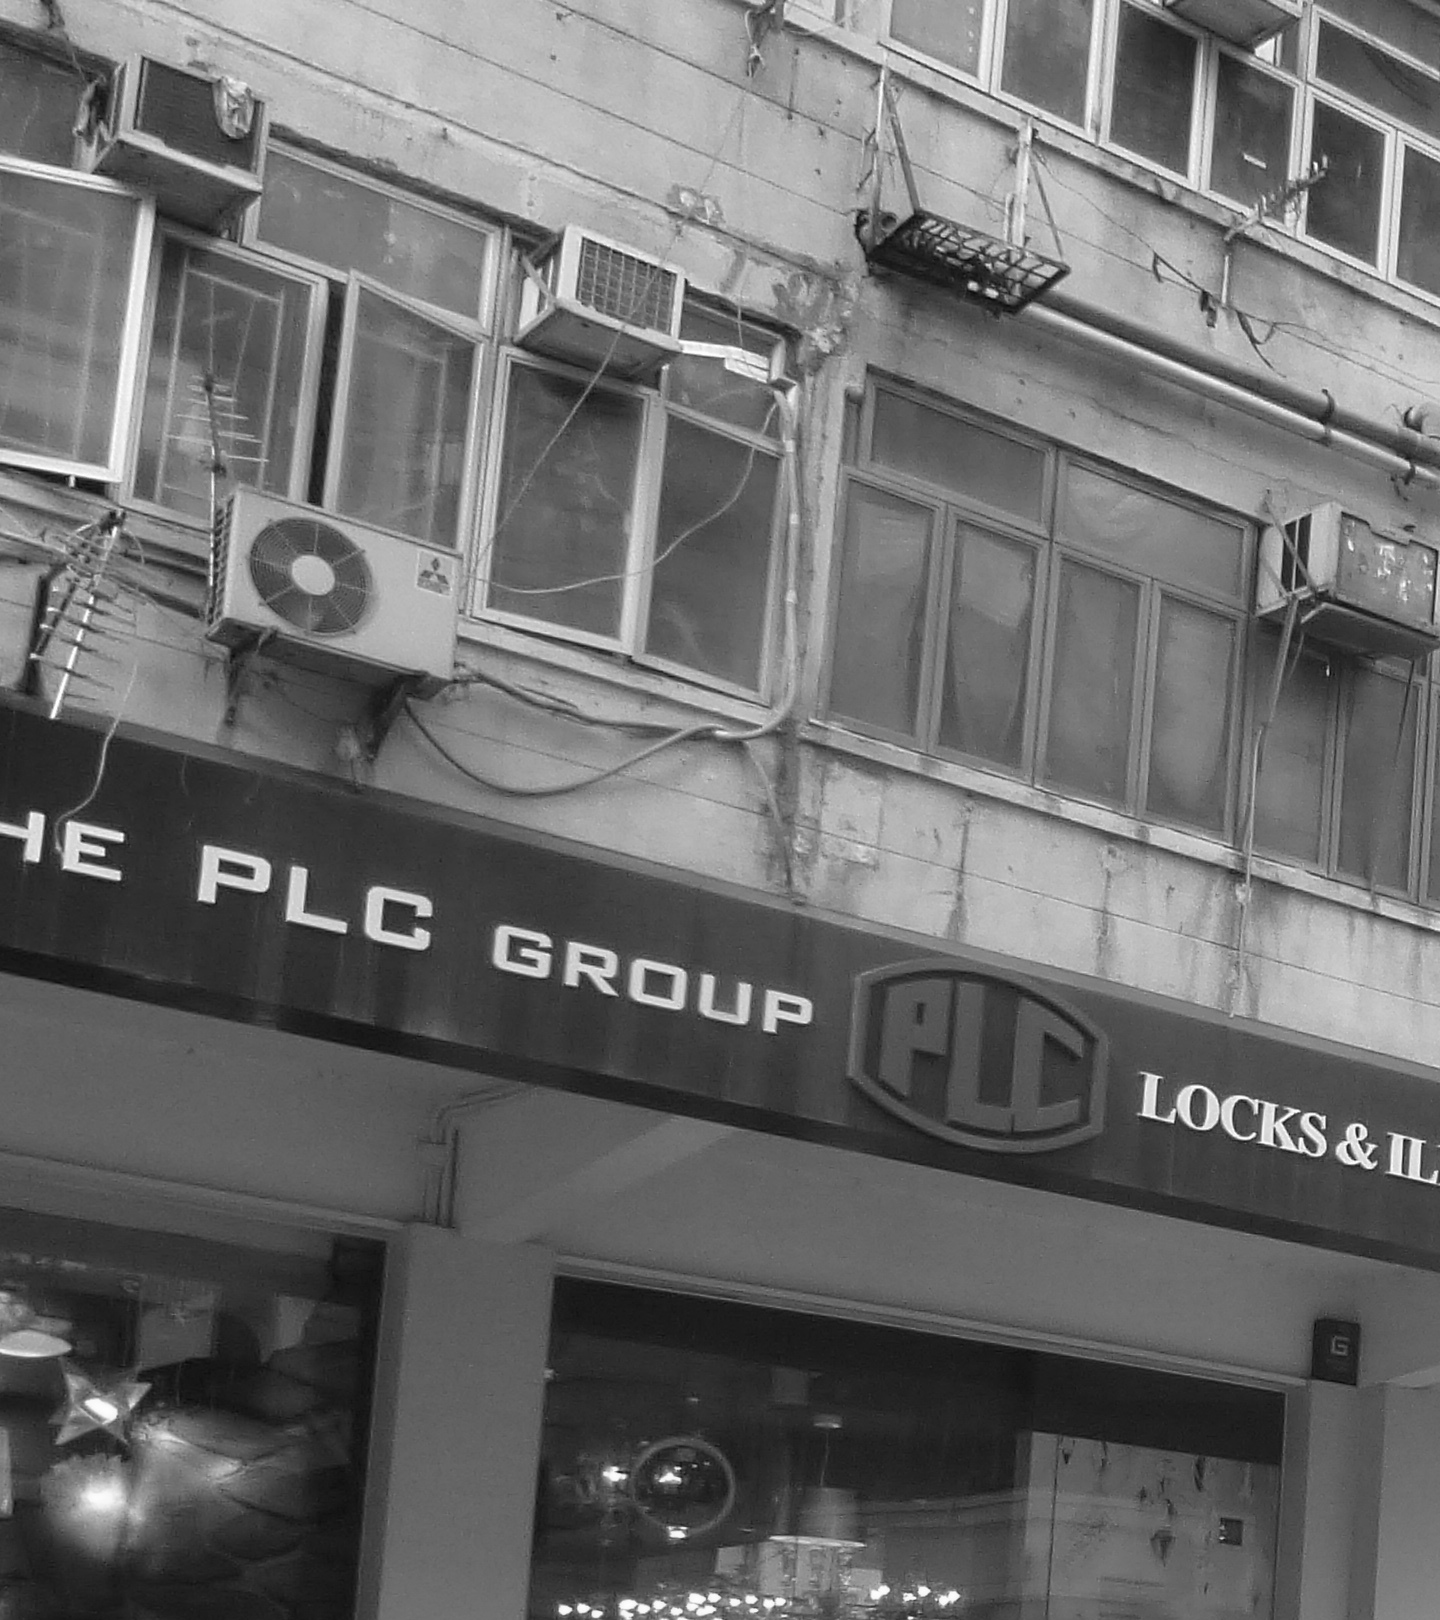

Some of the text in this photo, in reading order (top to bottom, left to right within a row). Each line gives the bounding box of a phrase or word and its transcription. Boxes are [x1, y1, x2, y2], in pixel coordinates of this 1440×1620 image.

[198, 844, 434, 952] PLC
[492, 922, 815, 1034] GROUP
[877, 977, 1085, 1134] PLC
[1136, 1070, 1329, 1158] LOCKS
[1335, 1121, 1379, 1171] &
